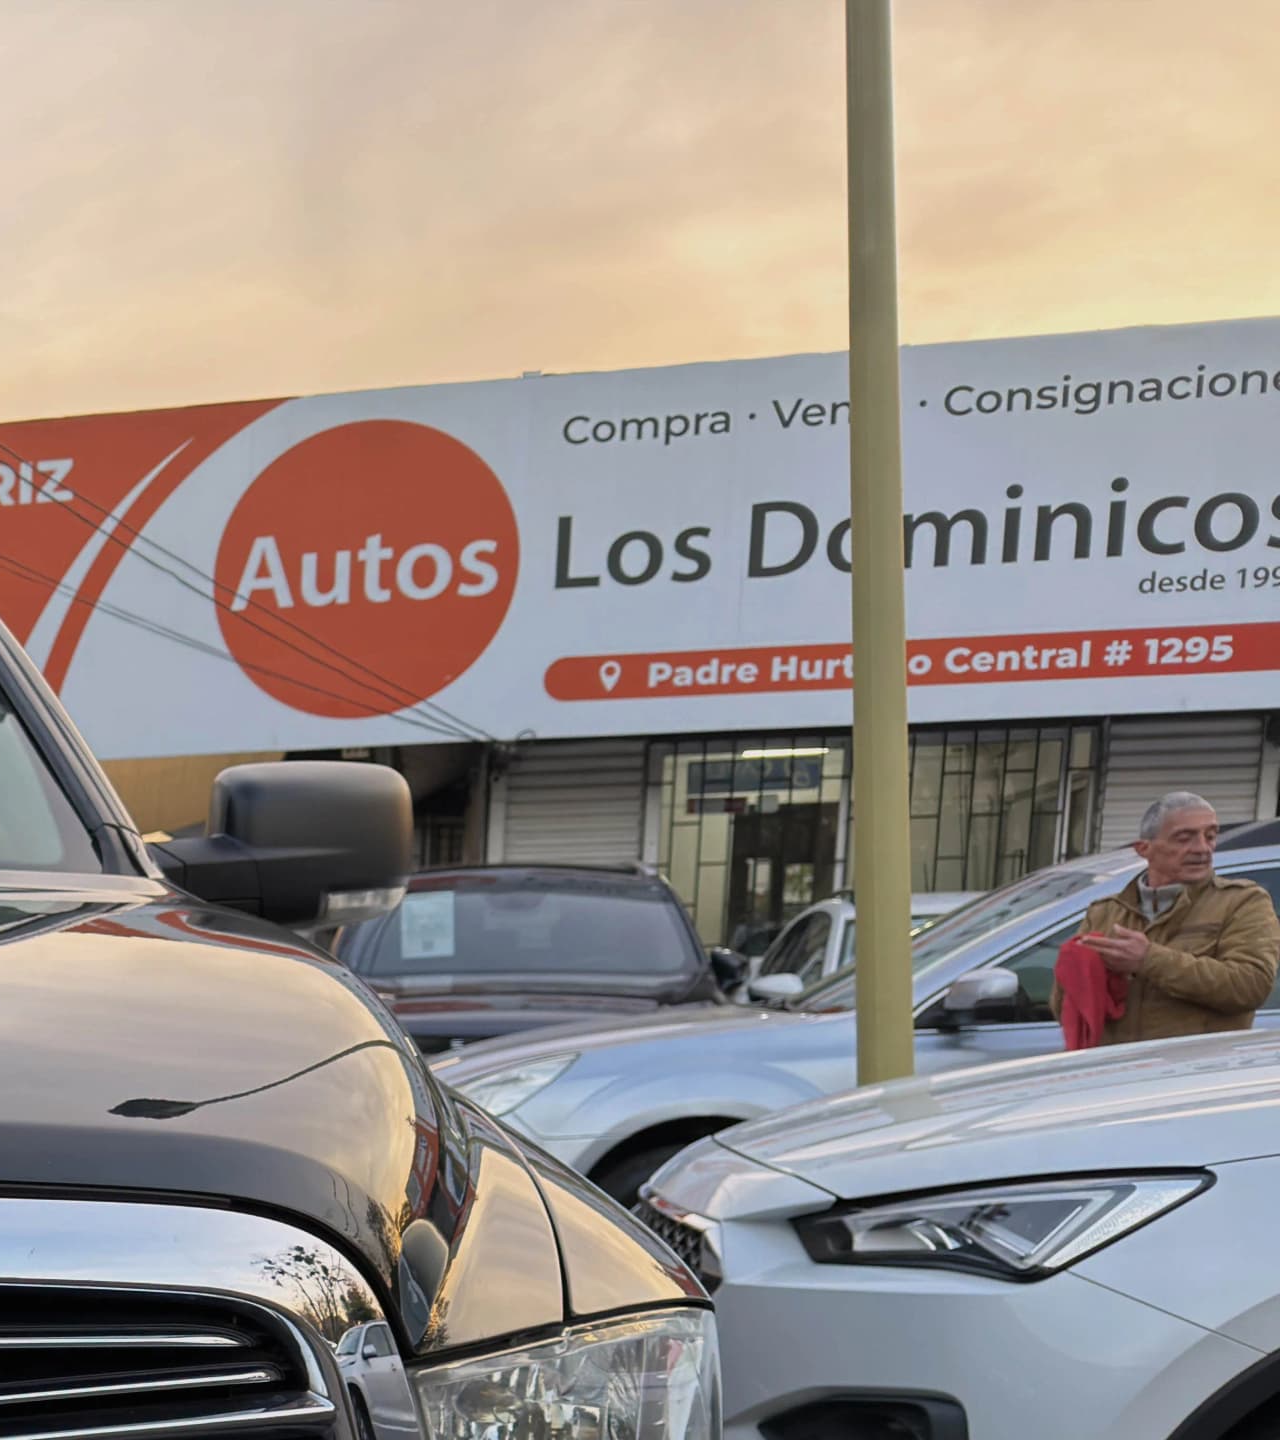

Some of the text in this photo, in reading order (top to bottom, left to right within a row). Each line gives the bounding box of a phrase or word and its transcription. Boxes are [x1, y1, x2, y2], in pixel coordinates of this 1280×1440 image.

[562, 410, 731, 446] Compra
[230, 533, 500, 613] Autos
[554, 516, 712, 590] Los
[1138, 568, 1226, 594] desde
[647, 635, 1234, 688] Padre Hurto Central # 1295
